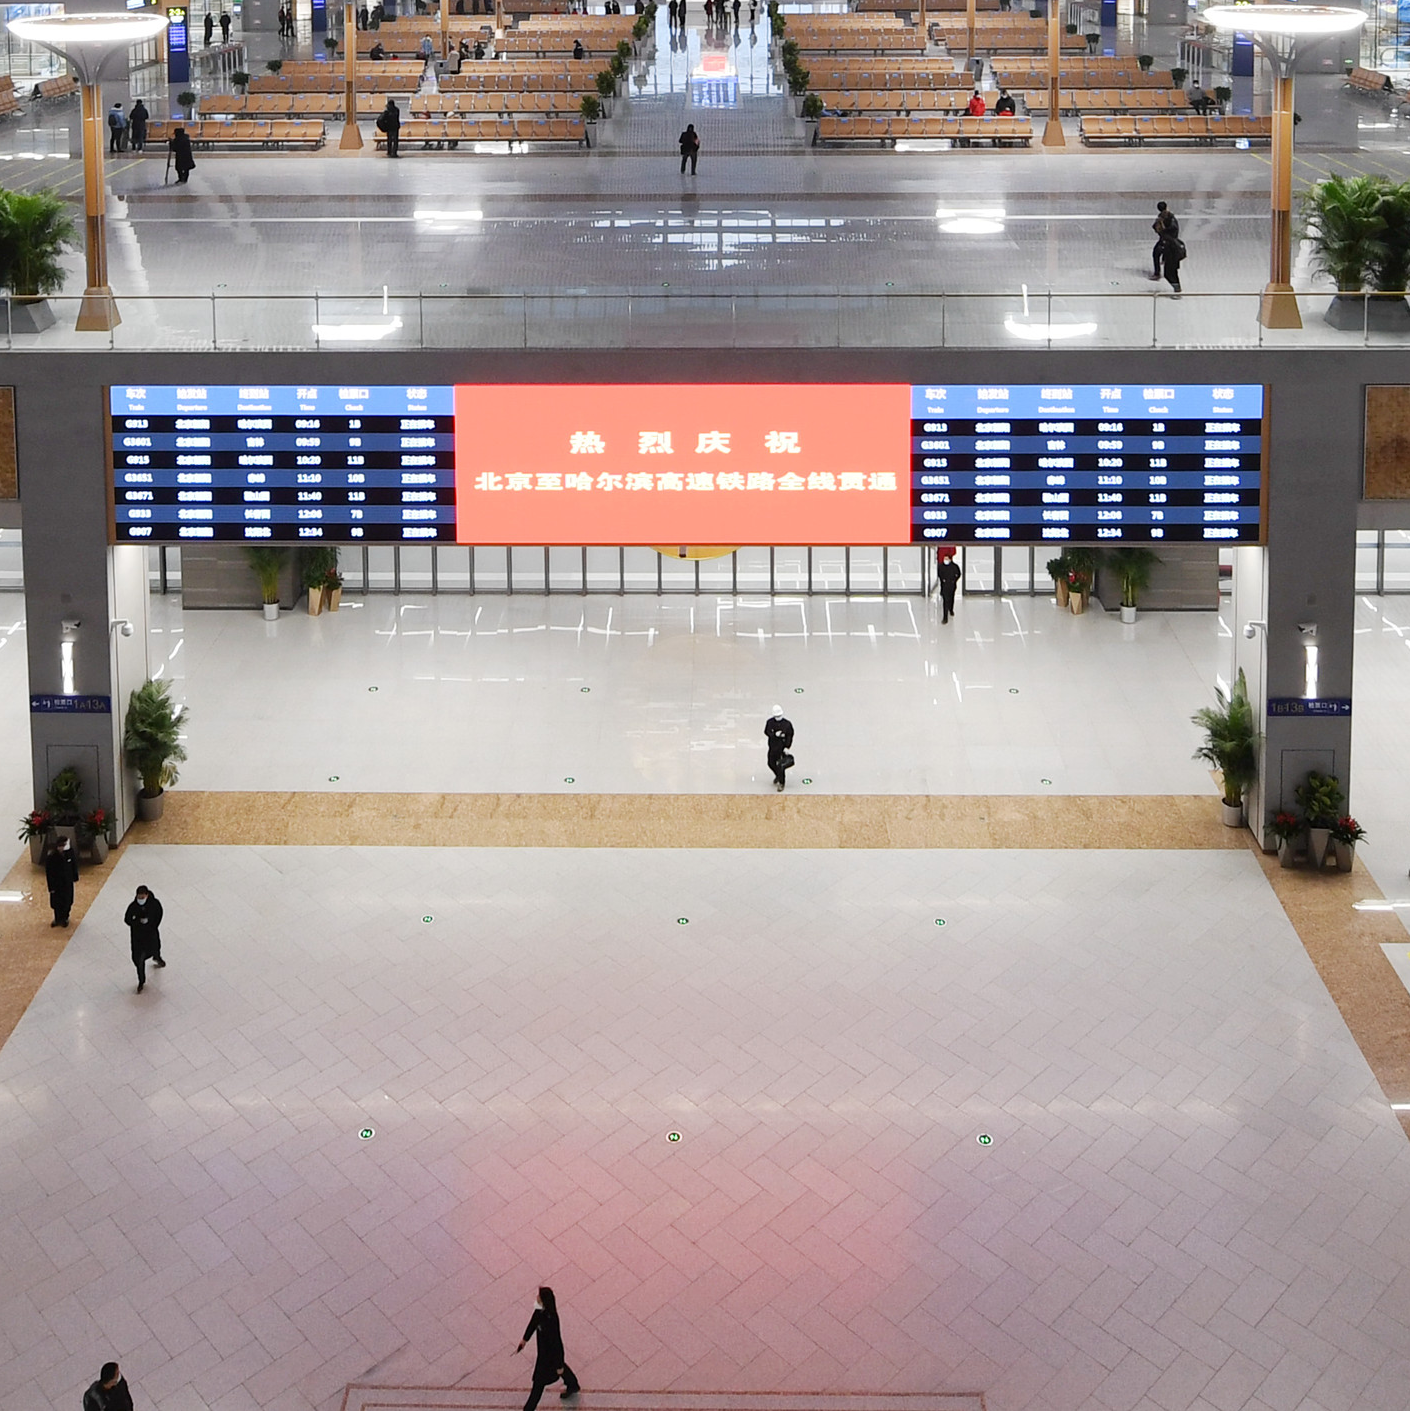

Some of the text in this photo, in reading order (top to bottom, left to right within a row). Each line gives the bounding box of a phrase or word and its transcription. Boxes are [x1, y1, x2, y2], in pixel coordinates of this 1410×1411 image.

[474, 471, 898, 492] 北京至哈尔滨高速铁路全线贯通
